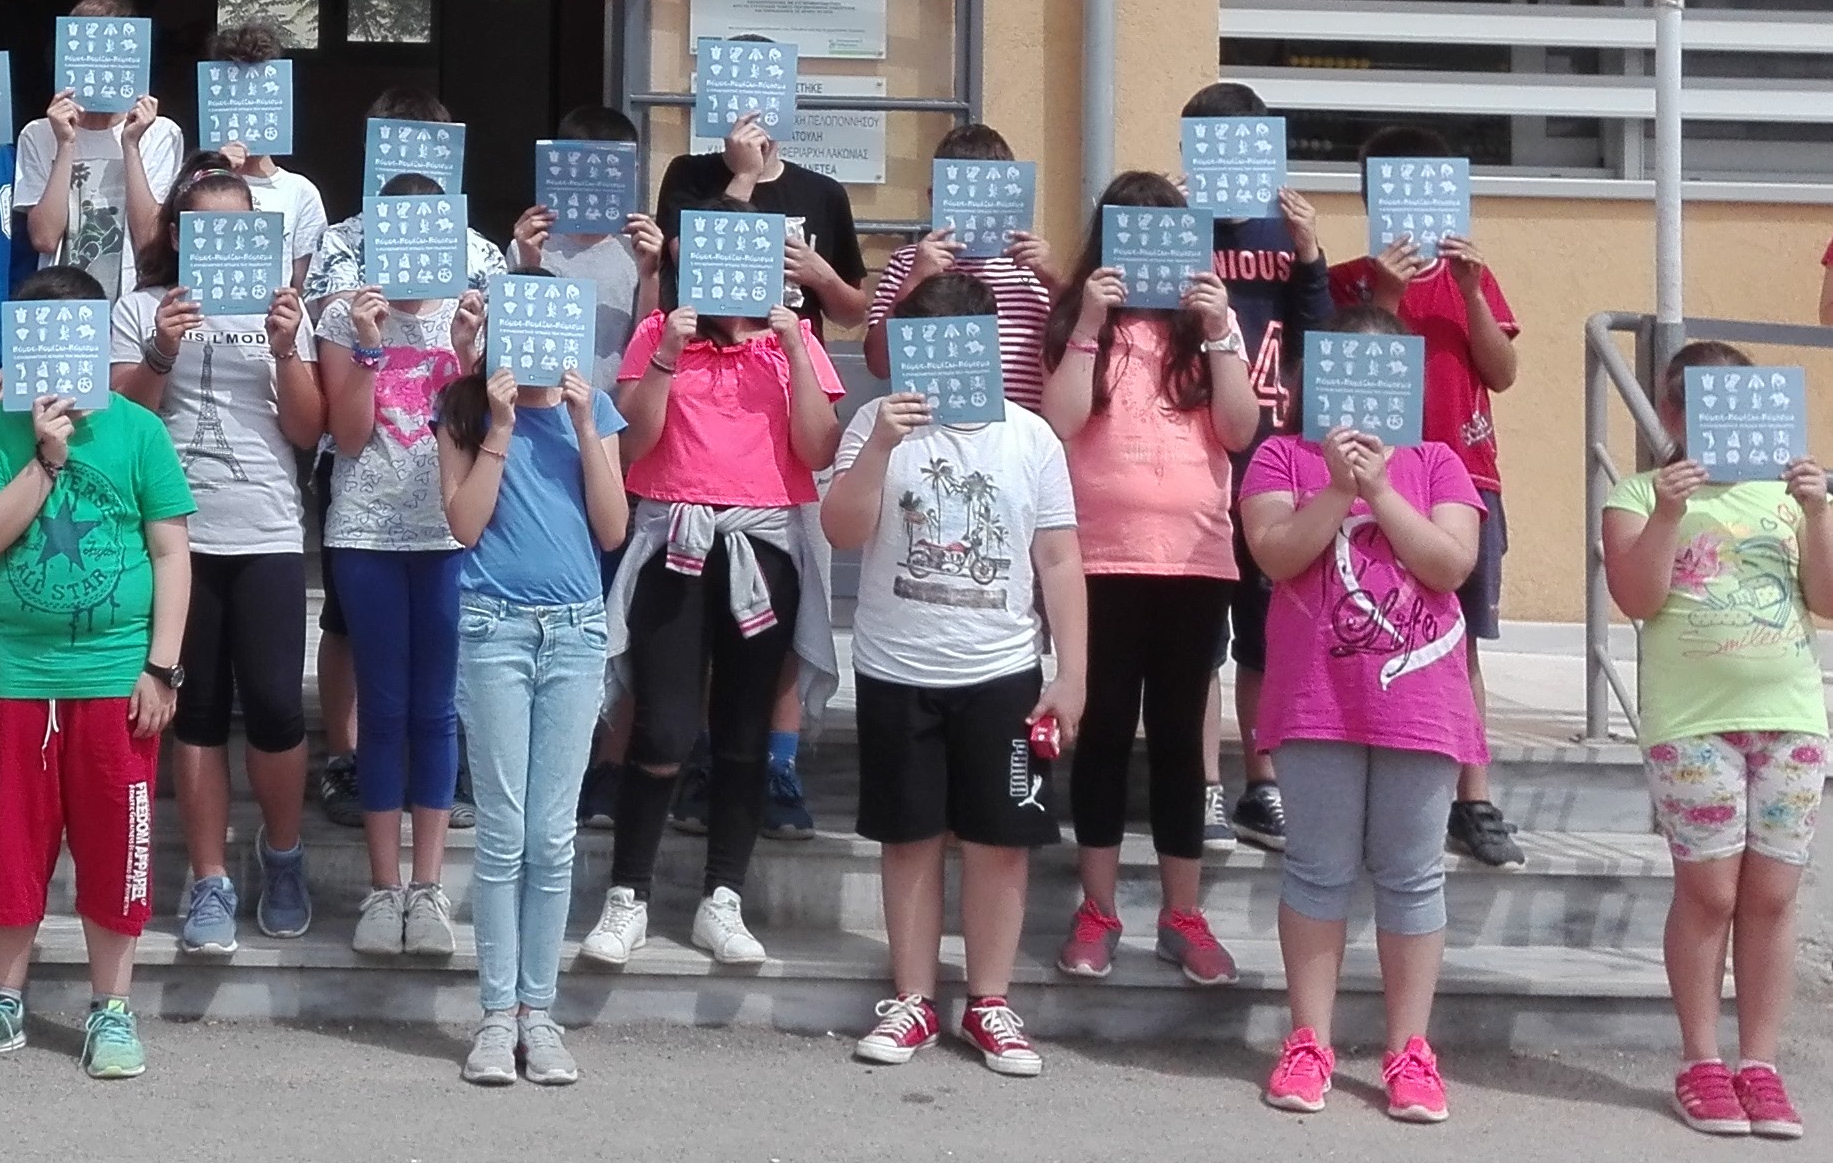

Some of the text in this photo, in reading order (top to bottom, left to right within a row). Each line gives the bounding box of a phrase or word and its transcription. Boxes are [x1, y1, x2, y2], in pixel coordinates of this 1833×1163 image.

[16, 561, 108, 600] ALL STAR
[131, 781, 150, 902] FREEDOM APPAREL
